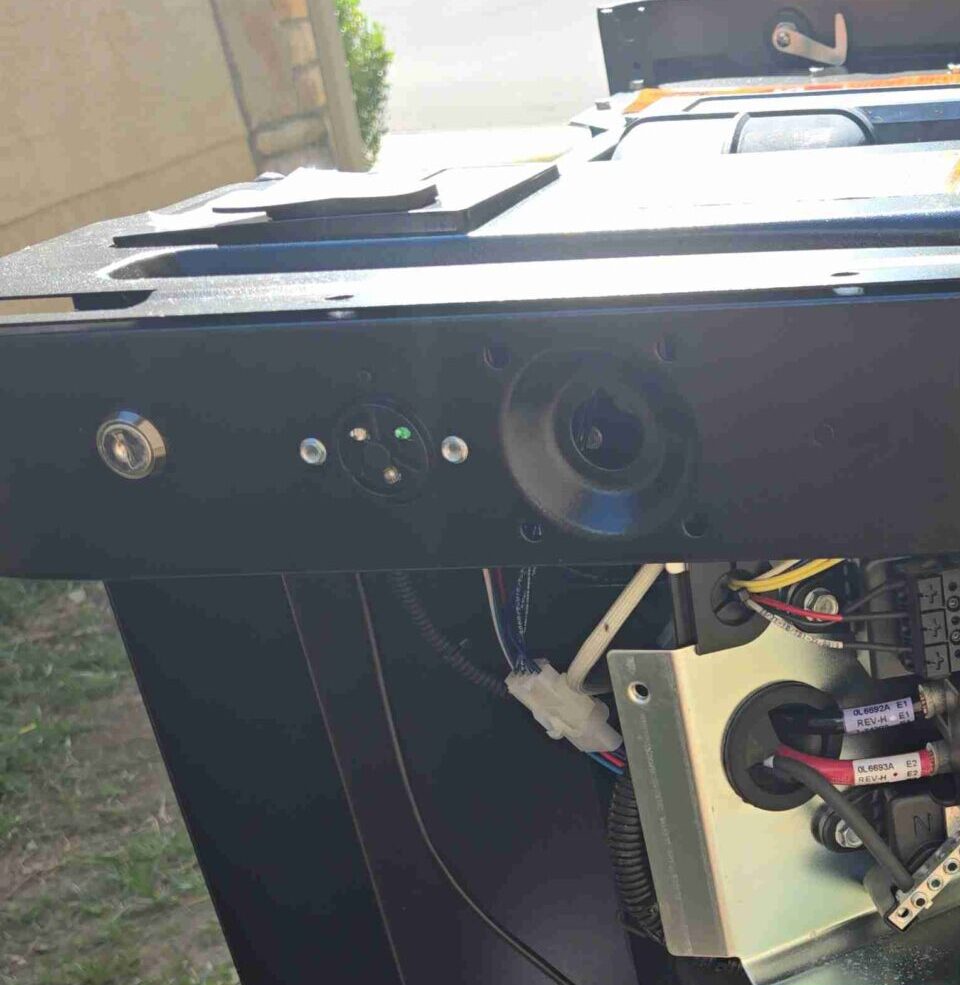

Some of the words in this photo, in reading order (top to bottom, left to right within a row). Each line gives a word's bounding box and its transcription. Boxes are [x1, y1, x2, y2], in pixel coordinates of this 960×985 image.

[896, 700, 908, 709] E1
[857, 716, 887, 727] REV-H
[898, 711, 910, 720] E1
[905, 760, 918, 768] E2
[858, 774, 887, 783] REV-H
[907, 770, 919, 778] E2
